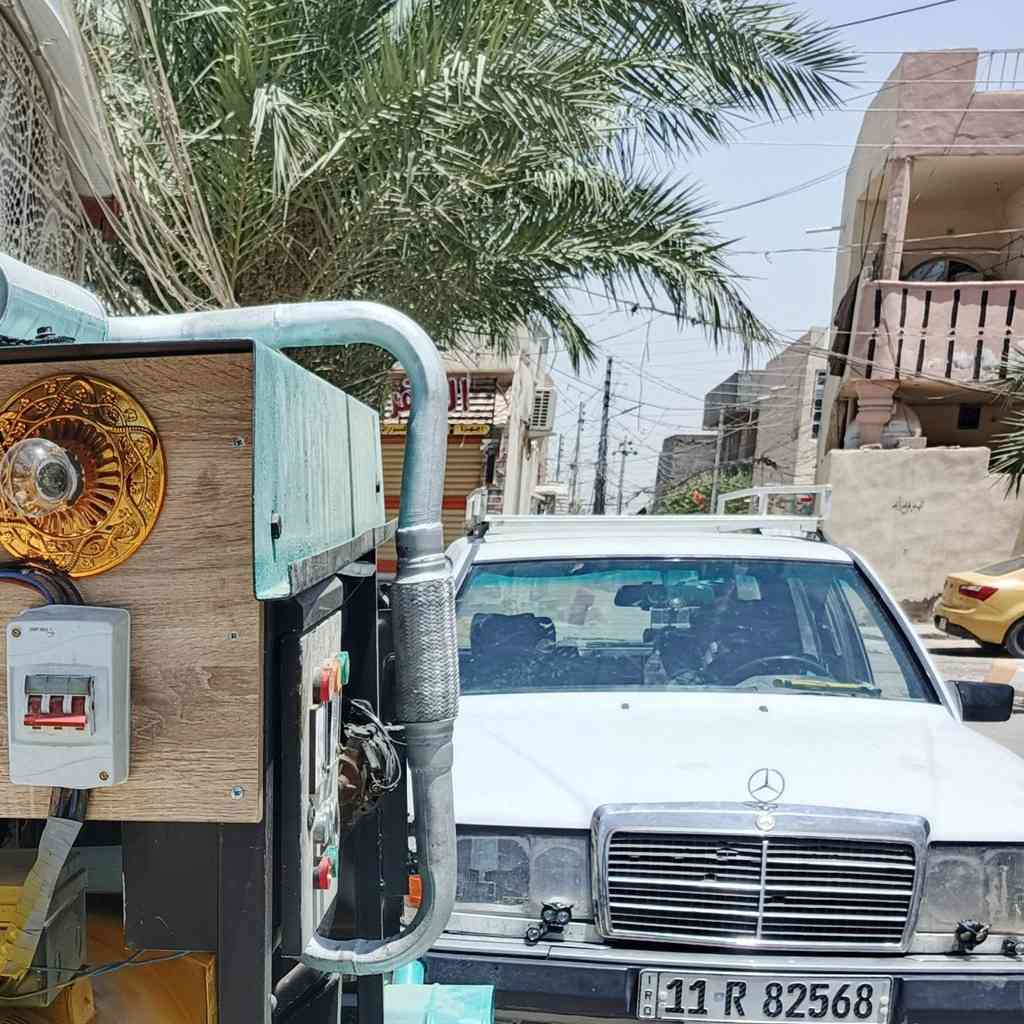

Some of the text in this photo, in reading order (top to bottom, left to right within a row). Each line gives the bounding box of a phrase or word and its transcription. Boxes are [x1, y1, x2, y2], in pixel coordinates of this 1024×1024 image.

[664, 979, 874, 1019] 11 R 82568
